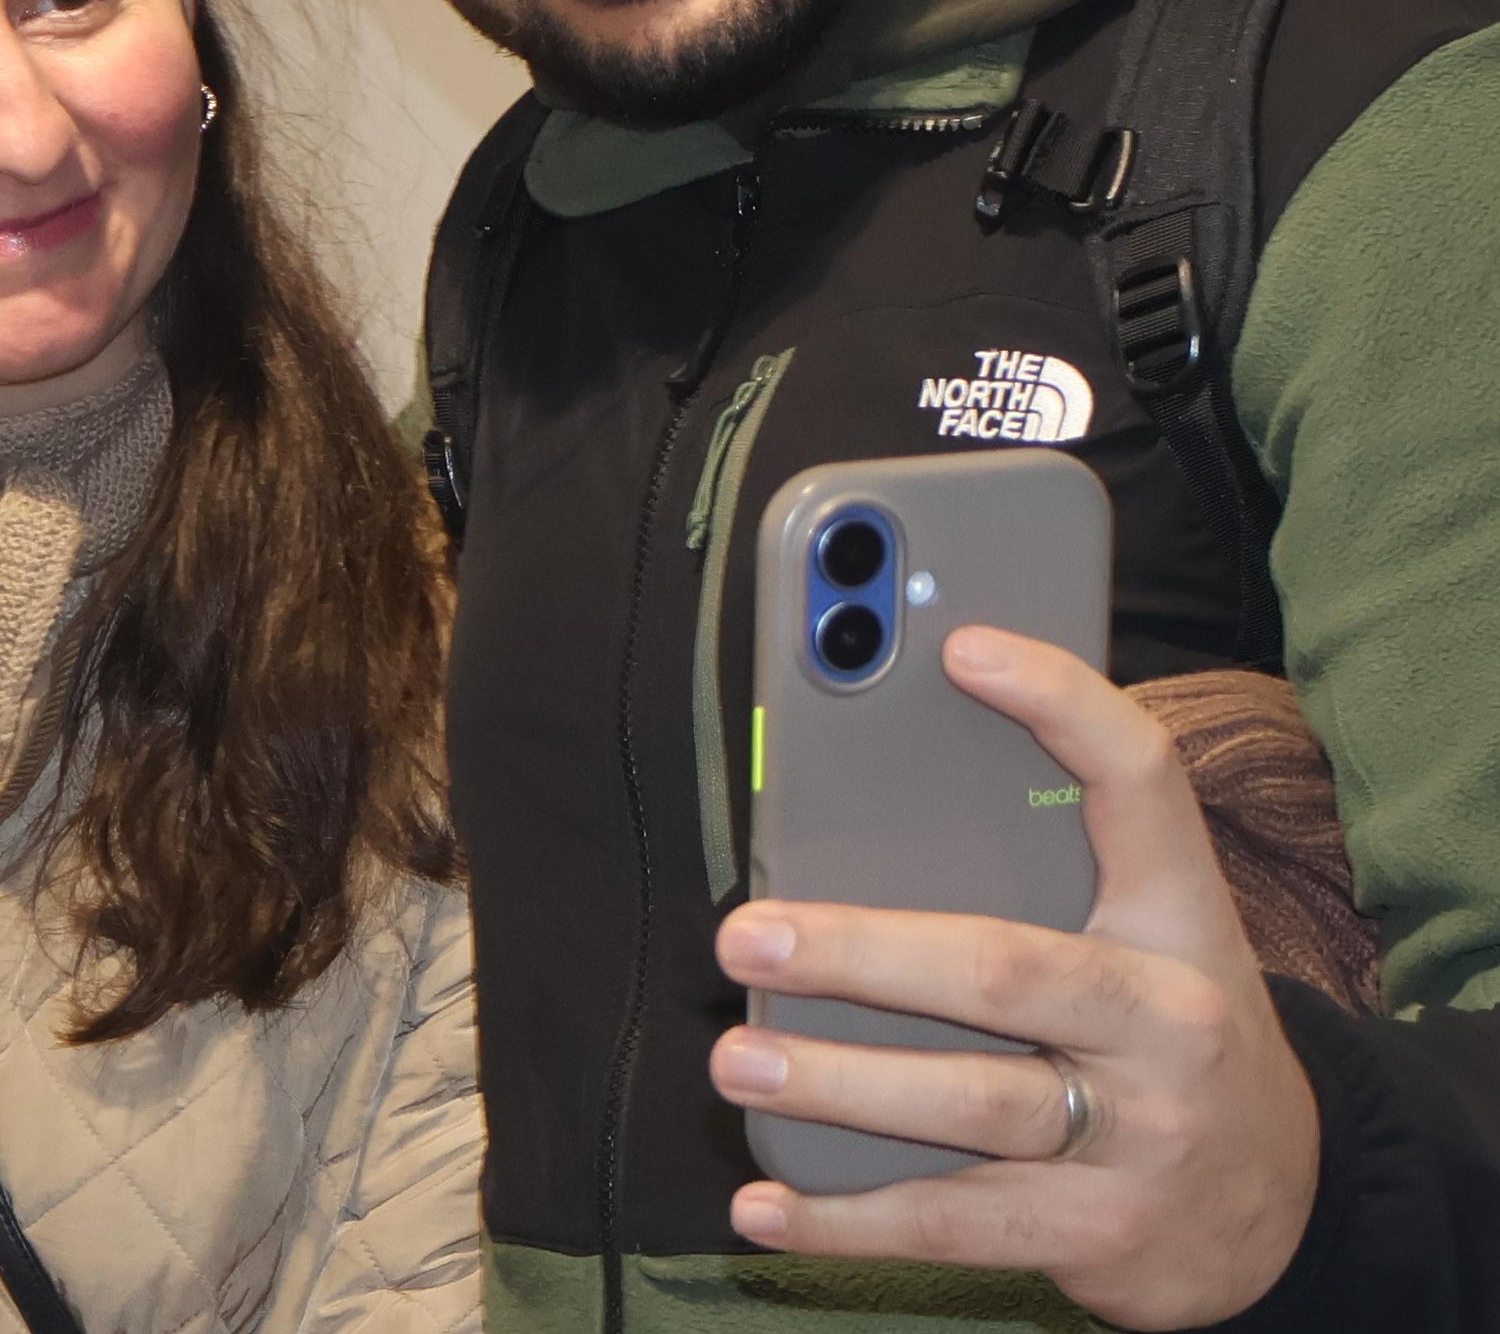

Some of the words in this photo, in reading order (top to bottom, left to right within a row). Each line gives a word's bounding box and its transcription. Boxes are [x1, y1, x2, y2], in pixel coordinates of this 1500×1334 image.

[974, 349, 1044, 381] THE
[917, 377, 1035, 411] NORTH
[937, 408, 1027, 440] FACE
